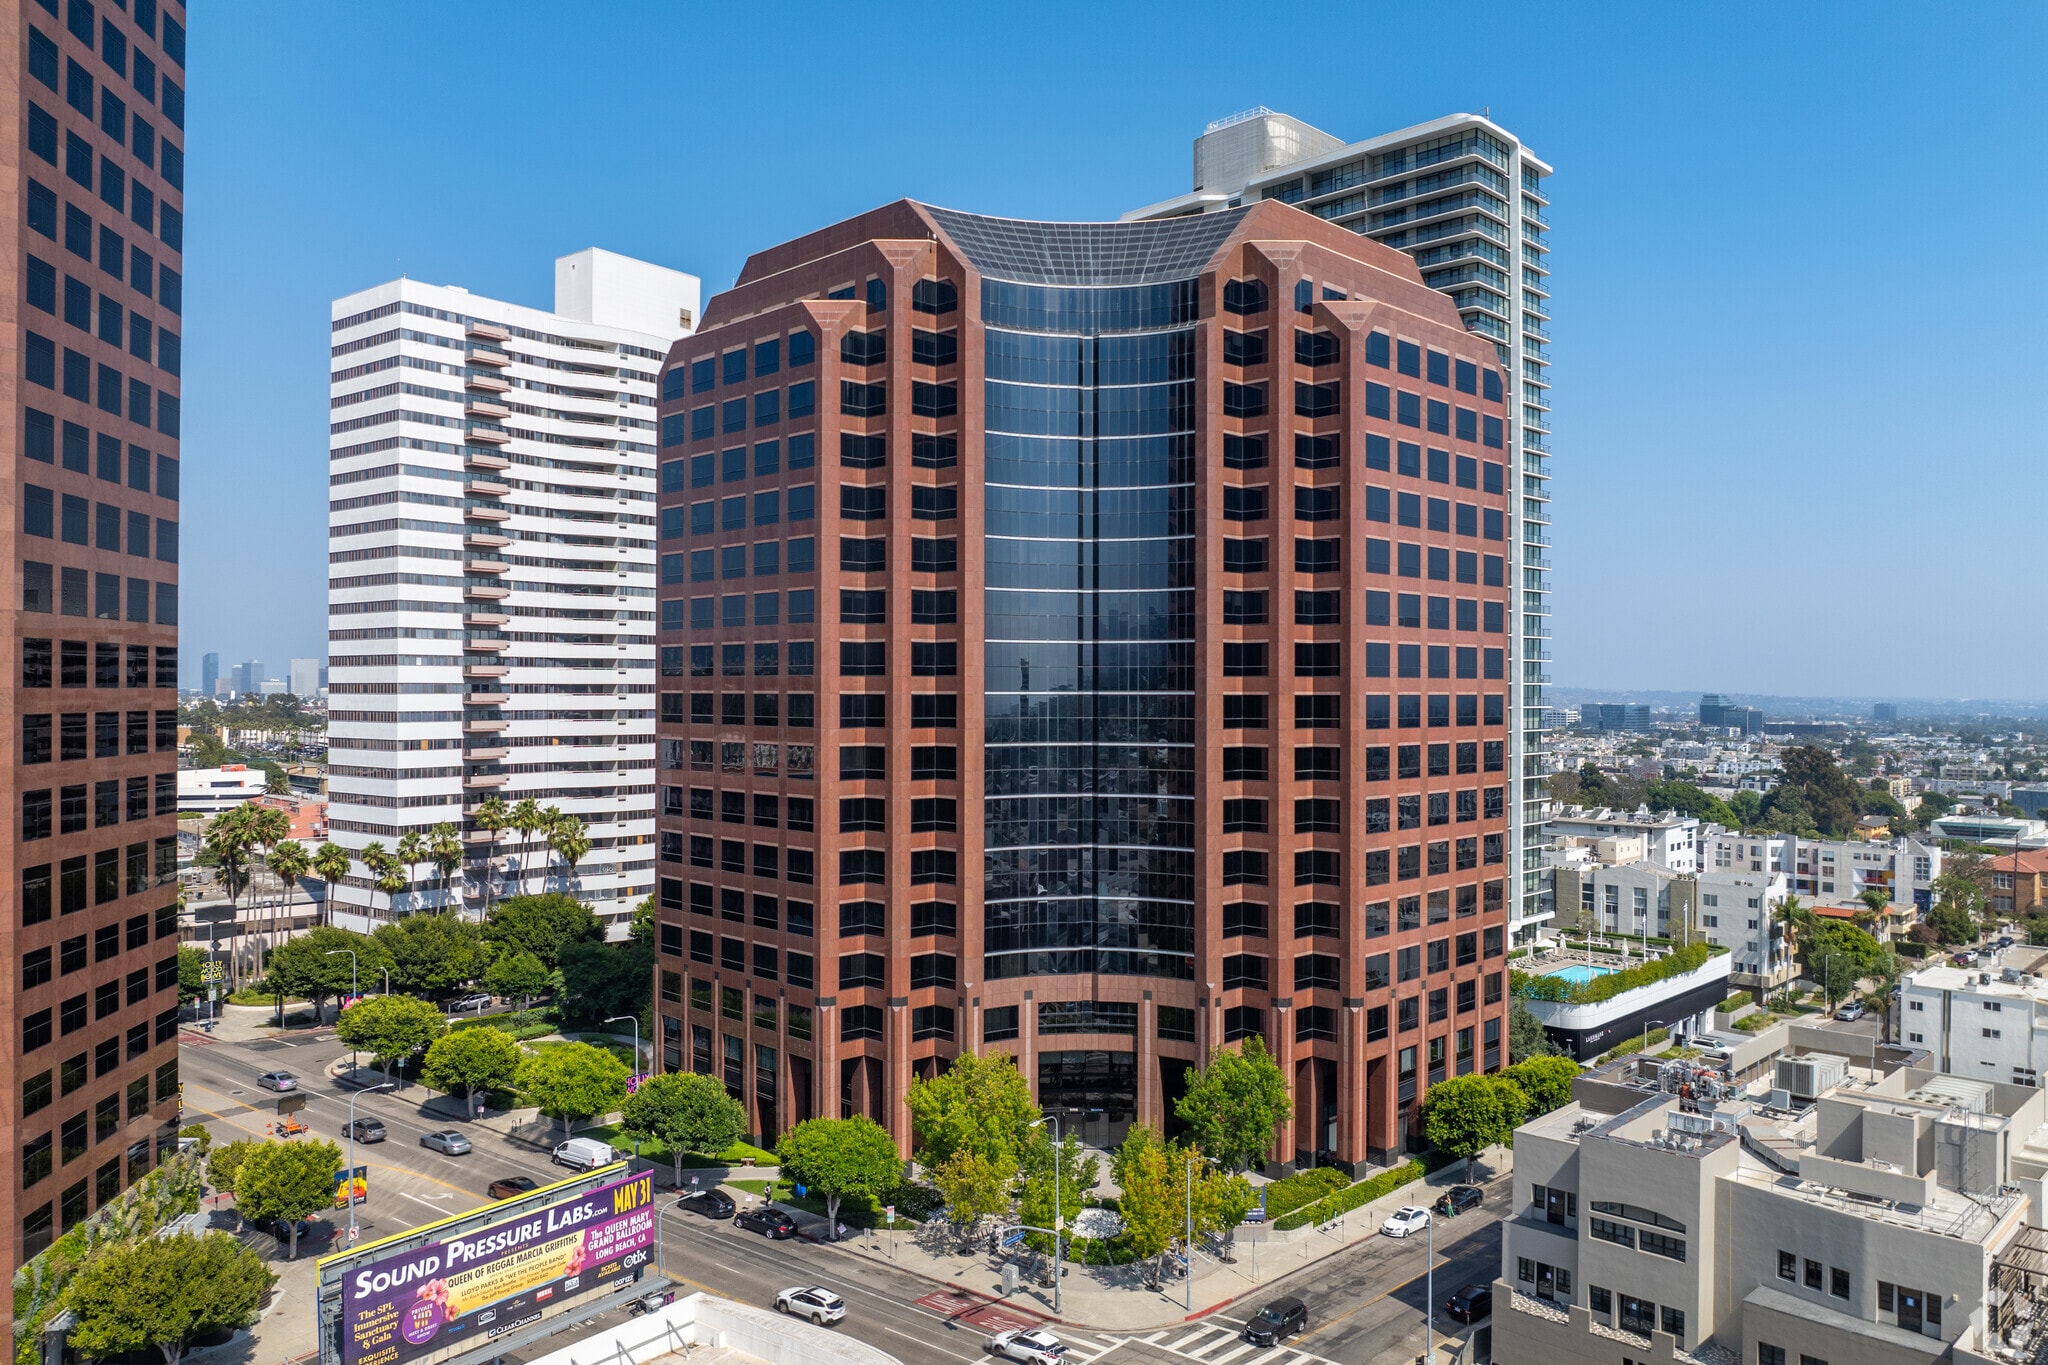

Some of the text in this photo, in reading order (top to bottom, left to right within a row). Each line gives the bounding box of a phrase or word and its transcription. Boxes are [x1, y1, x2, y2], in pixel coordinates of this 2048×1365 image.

[613, 1177, 651, 1215] MAY 31
[588, 1219, 653, 1251] GRAND BALLROOM
[591, 1210, 650, 1240] The QUEEN MARY
[501, 1243, 529, 1256] PRESENTS
[595, 1233, 646, 1260] LONG BEACH, CA
[354, 1256, 440, 1299] SOUND
[446, 1219, 542, 1268] PRESSURE
[448, 1235, 578, 1288] QUEEN OF REGGAE MARCIA GRIFFITHS
[461, 1286, 480, 1297] LLOYD
[481, 1279, 499, 1289] PARKS
[517, 1268, 527, 1276] THE
[529, 1261, 547, 1271] PEOPLE
[353, 1311, 399, 1332] Immersive
[358, 1301, 395, 1321] The SPL
[411, 1303, 433, 1316] PRIVATE
[354, 1320, 399, 1342] Sanctuary
[362, 1332, 392, 1350] & Gala
[358, 1345, 396, 1365] EXQUISITE
